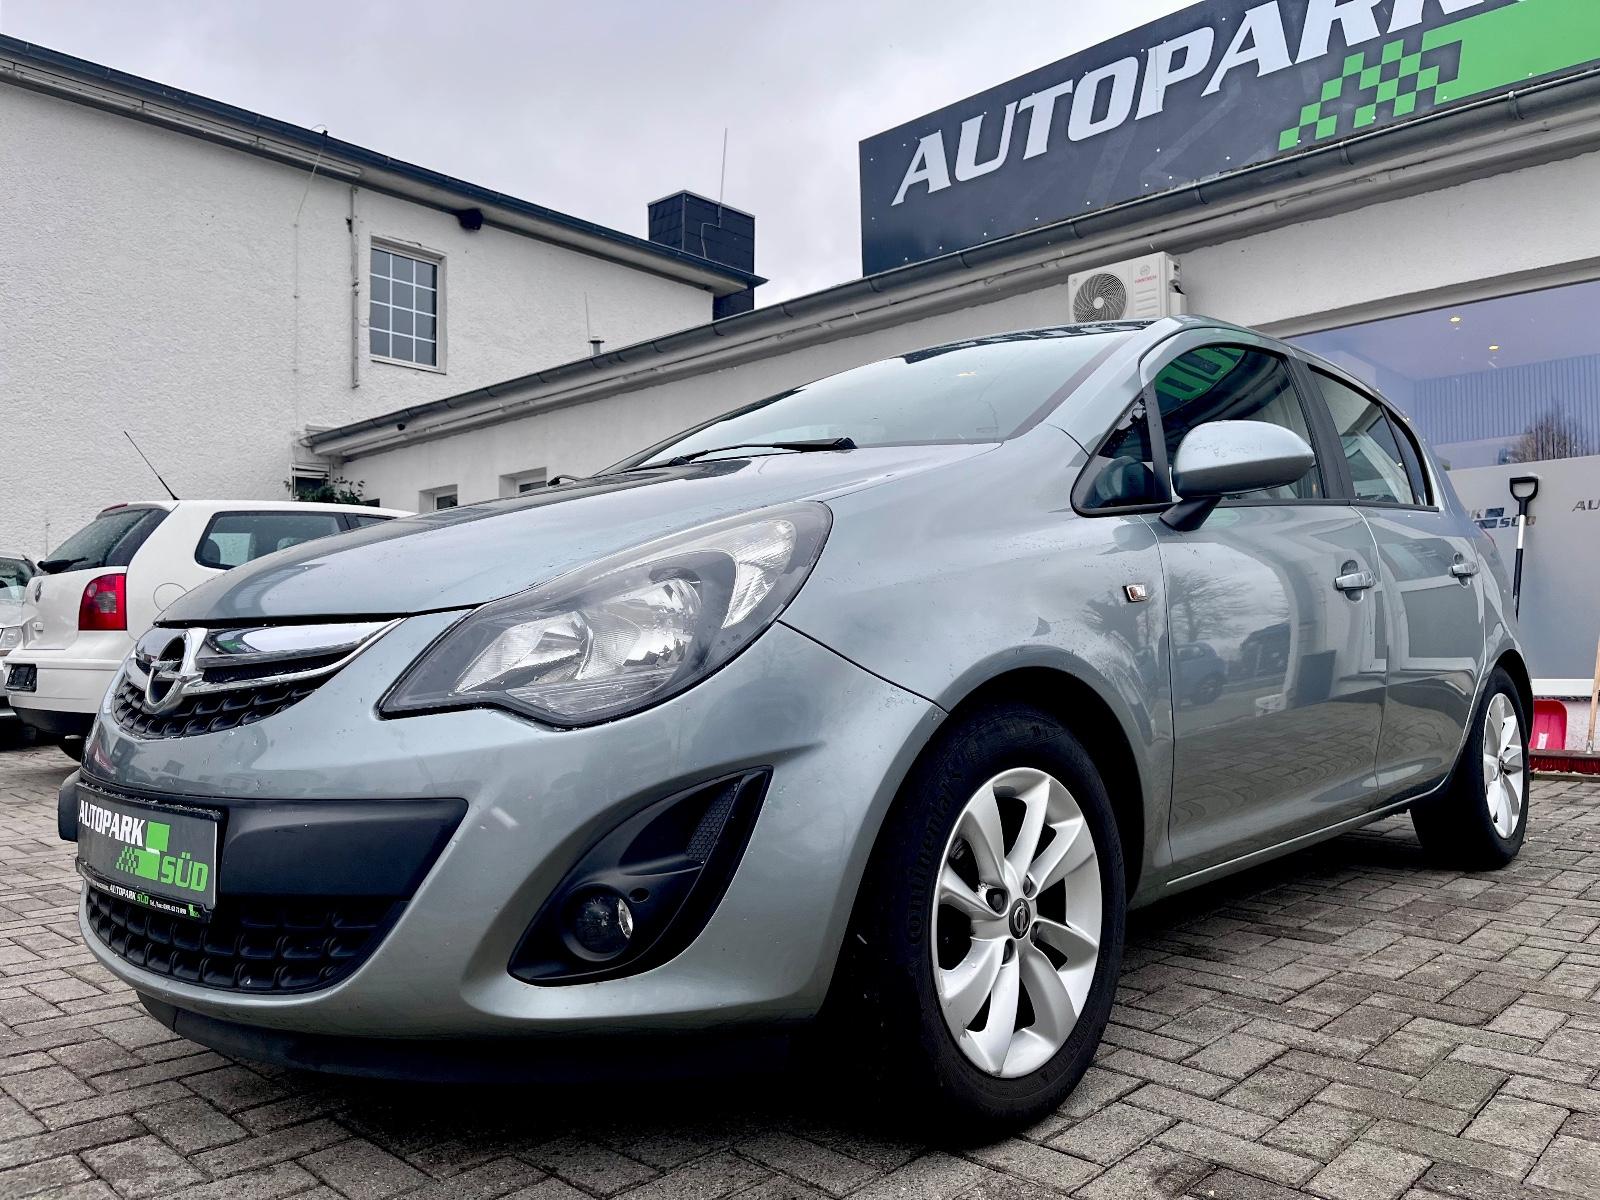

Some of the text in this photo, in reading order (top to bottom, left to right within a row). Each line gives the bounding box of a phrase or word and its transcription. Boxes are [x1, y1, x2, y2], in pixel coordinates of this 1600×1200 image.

[79, 800, 146, 846] AUTOPARK
[161, 852, 208, 892] SÜD
[110, 885, 136, 901] AUTOPARK
